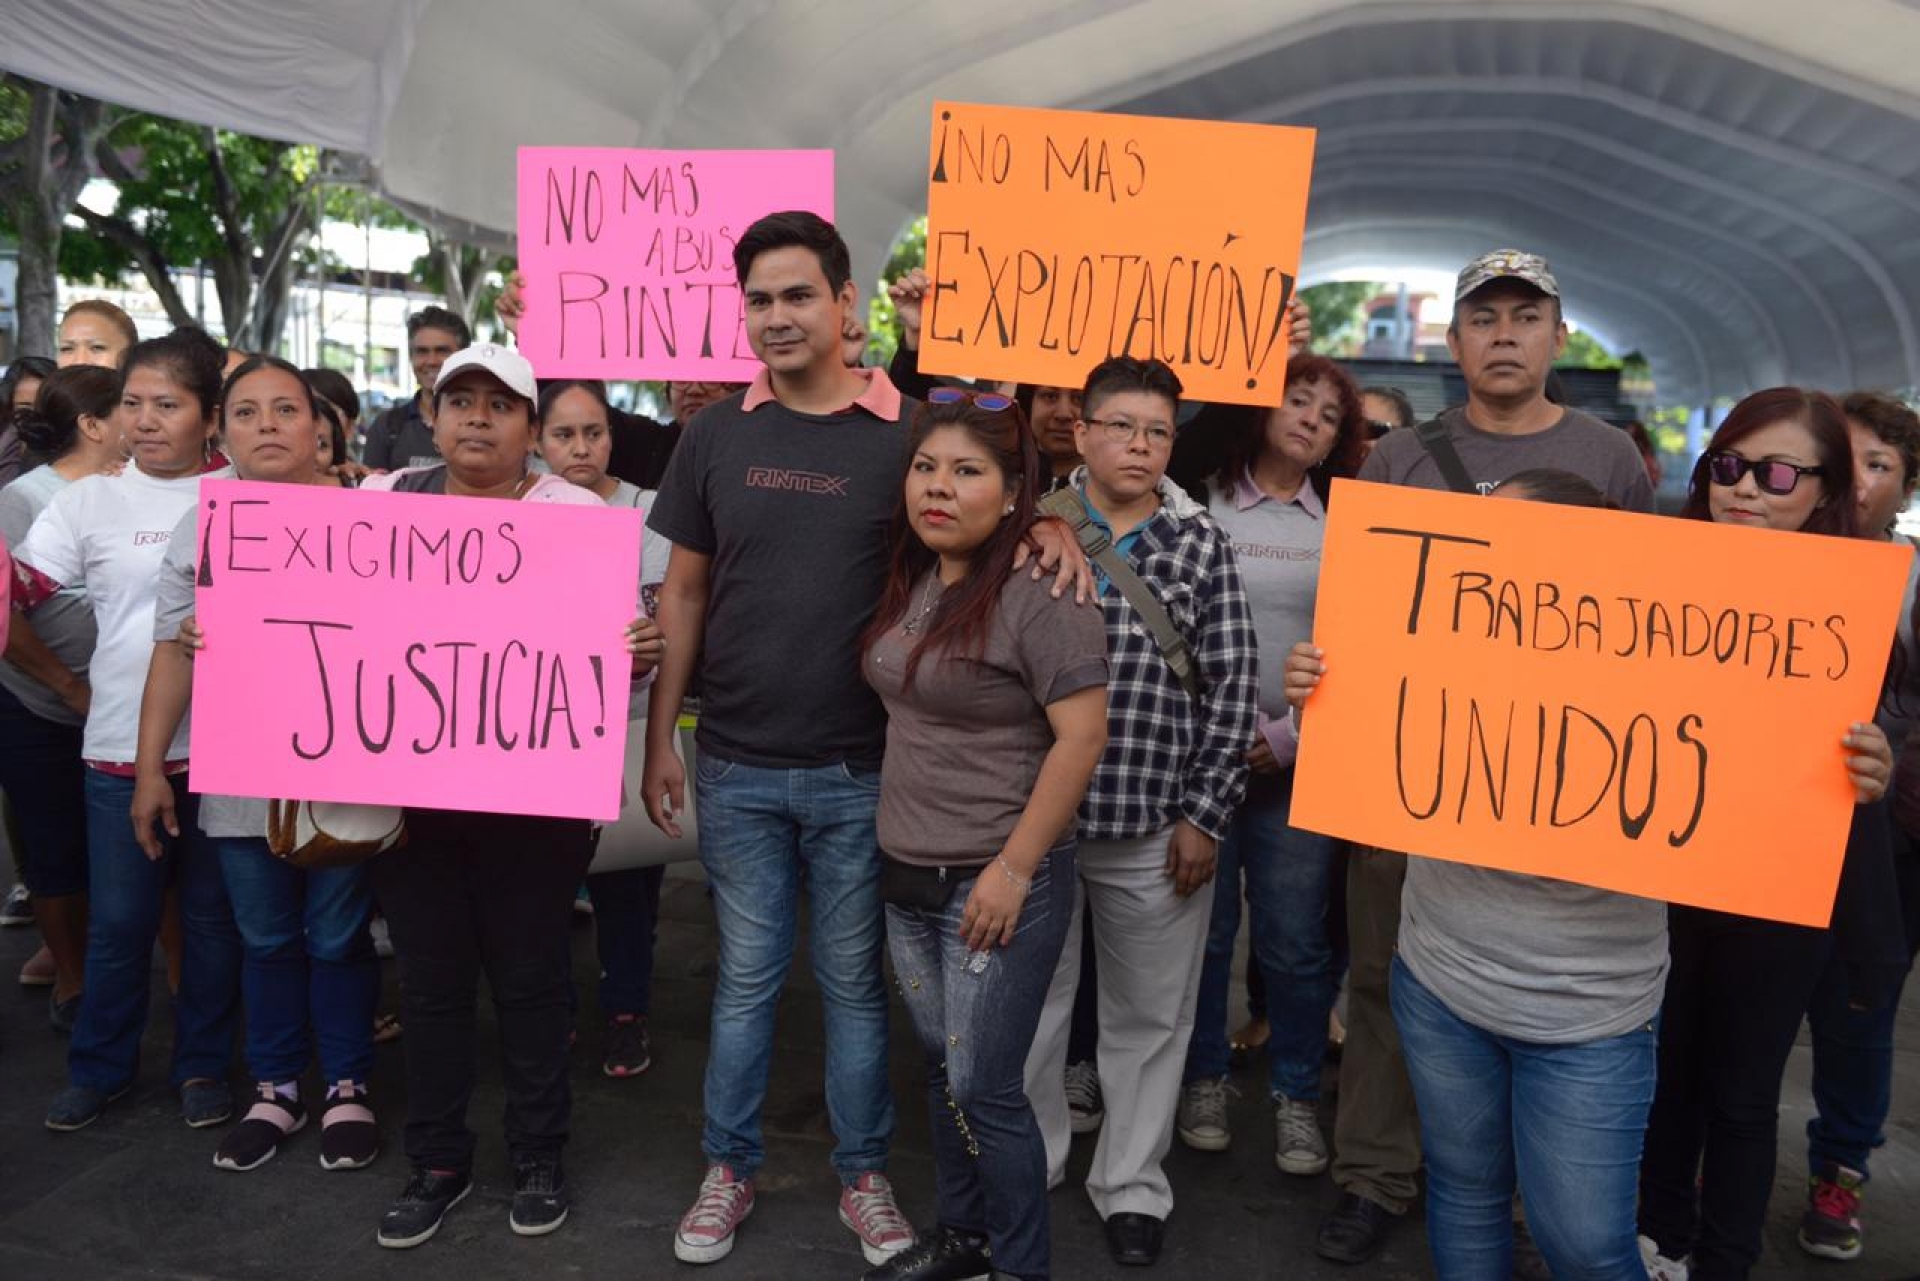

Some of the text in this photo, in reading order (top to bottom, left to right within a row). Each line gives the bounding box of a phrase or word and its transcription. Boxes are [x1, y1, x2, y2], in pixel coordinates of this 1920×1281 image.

[546, 162, 700, 246] NO MAS
[931, 110, 1146, 202] ¡NO MAS
[929, 230, 1297, 391] EXPLOTACIÓN!
[745, 466, 850, 495] RINTEX
[1366, 526, 1850, 682] TRABAJADORES
[1395, 676, 1709, 848] UNIDOS
